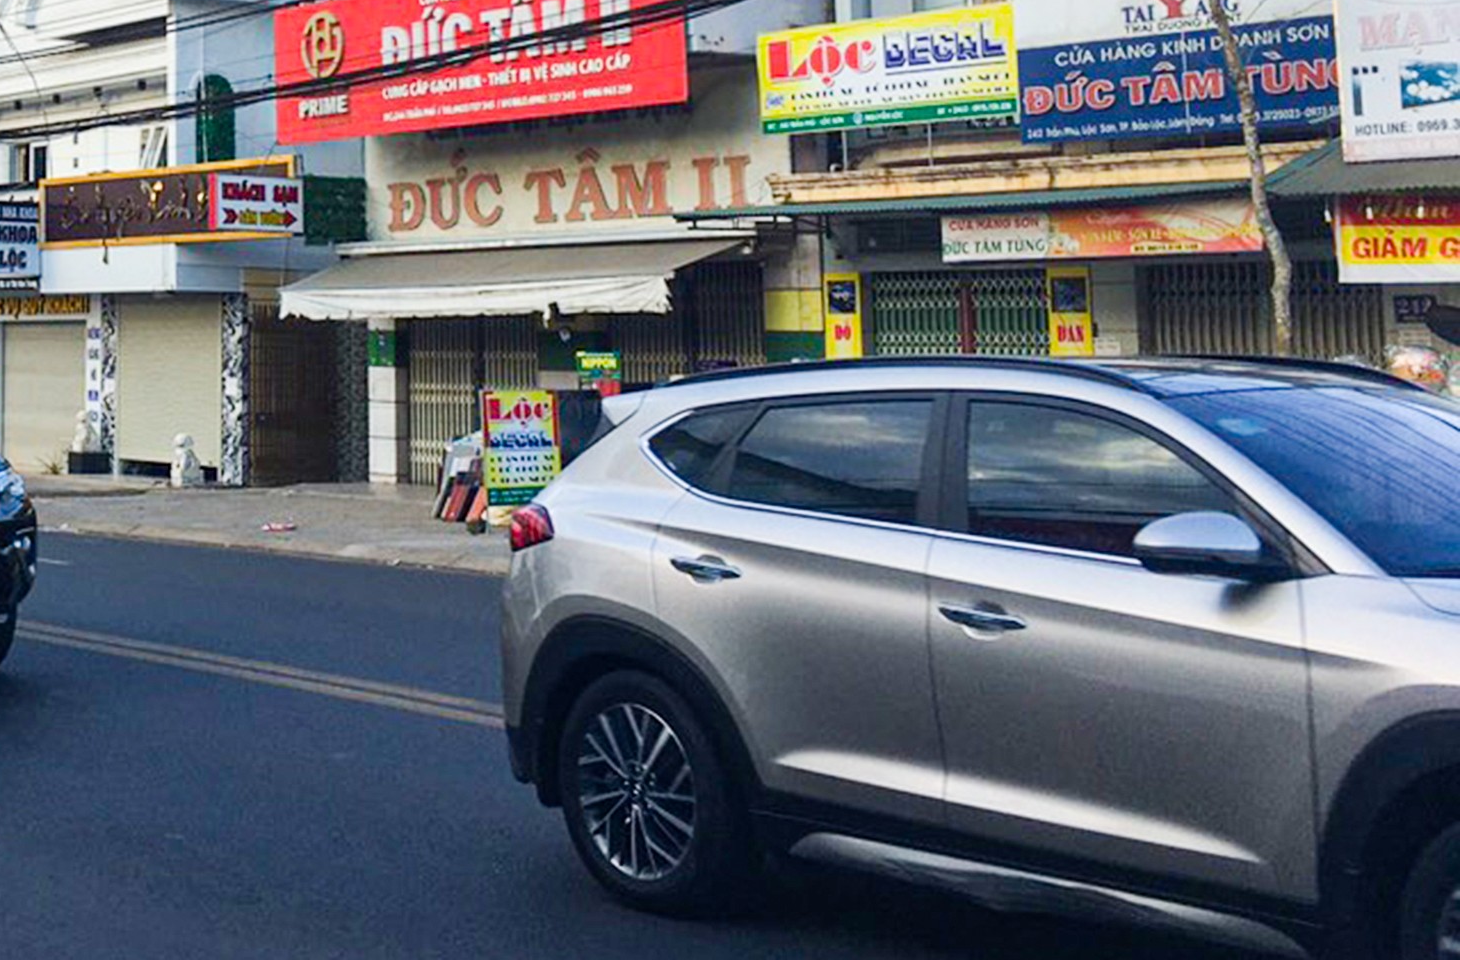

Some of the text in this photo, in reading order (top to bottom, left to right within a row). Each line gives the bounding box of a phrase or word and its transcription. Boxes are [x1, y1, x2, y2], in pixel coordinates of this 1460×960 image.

[768, 22, 1006, 87] LỘC DECAL
[1054, 43, 1095, 67] CỬA
[1100, 37, 1156, 62] HÀNG
[1162, 37, 1206, 56] KINH
[1286, 23, 1330, 42] SƠN
[298, 94, 349, 119] PRIME
[1023, 70, 1116, 116] ĐỨC
[1121, 61, 1225, 107] TÂM
[1354, 123, 1413, 138] HOTLINE:
[386, 146, 751, 232] ĐỨC TÂM II
[1352, 227, 1427, 259] GIẢM
[489, 397, 552, 427] LỘC
